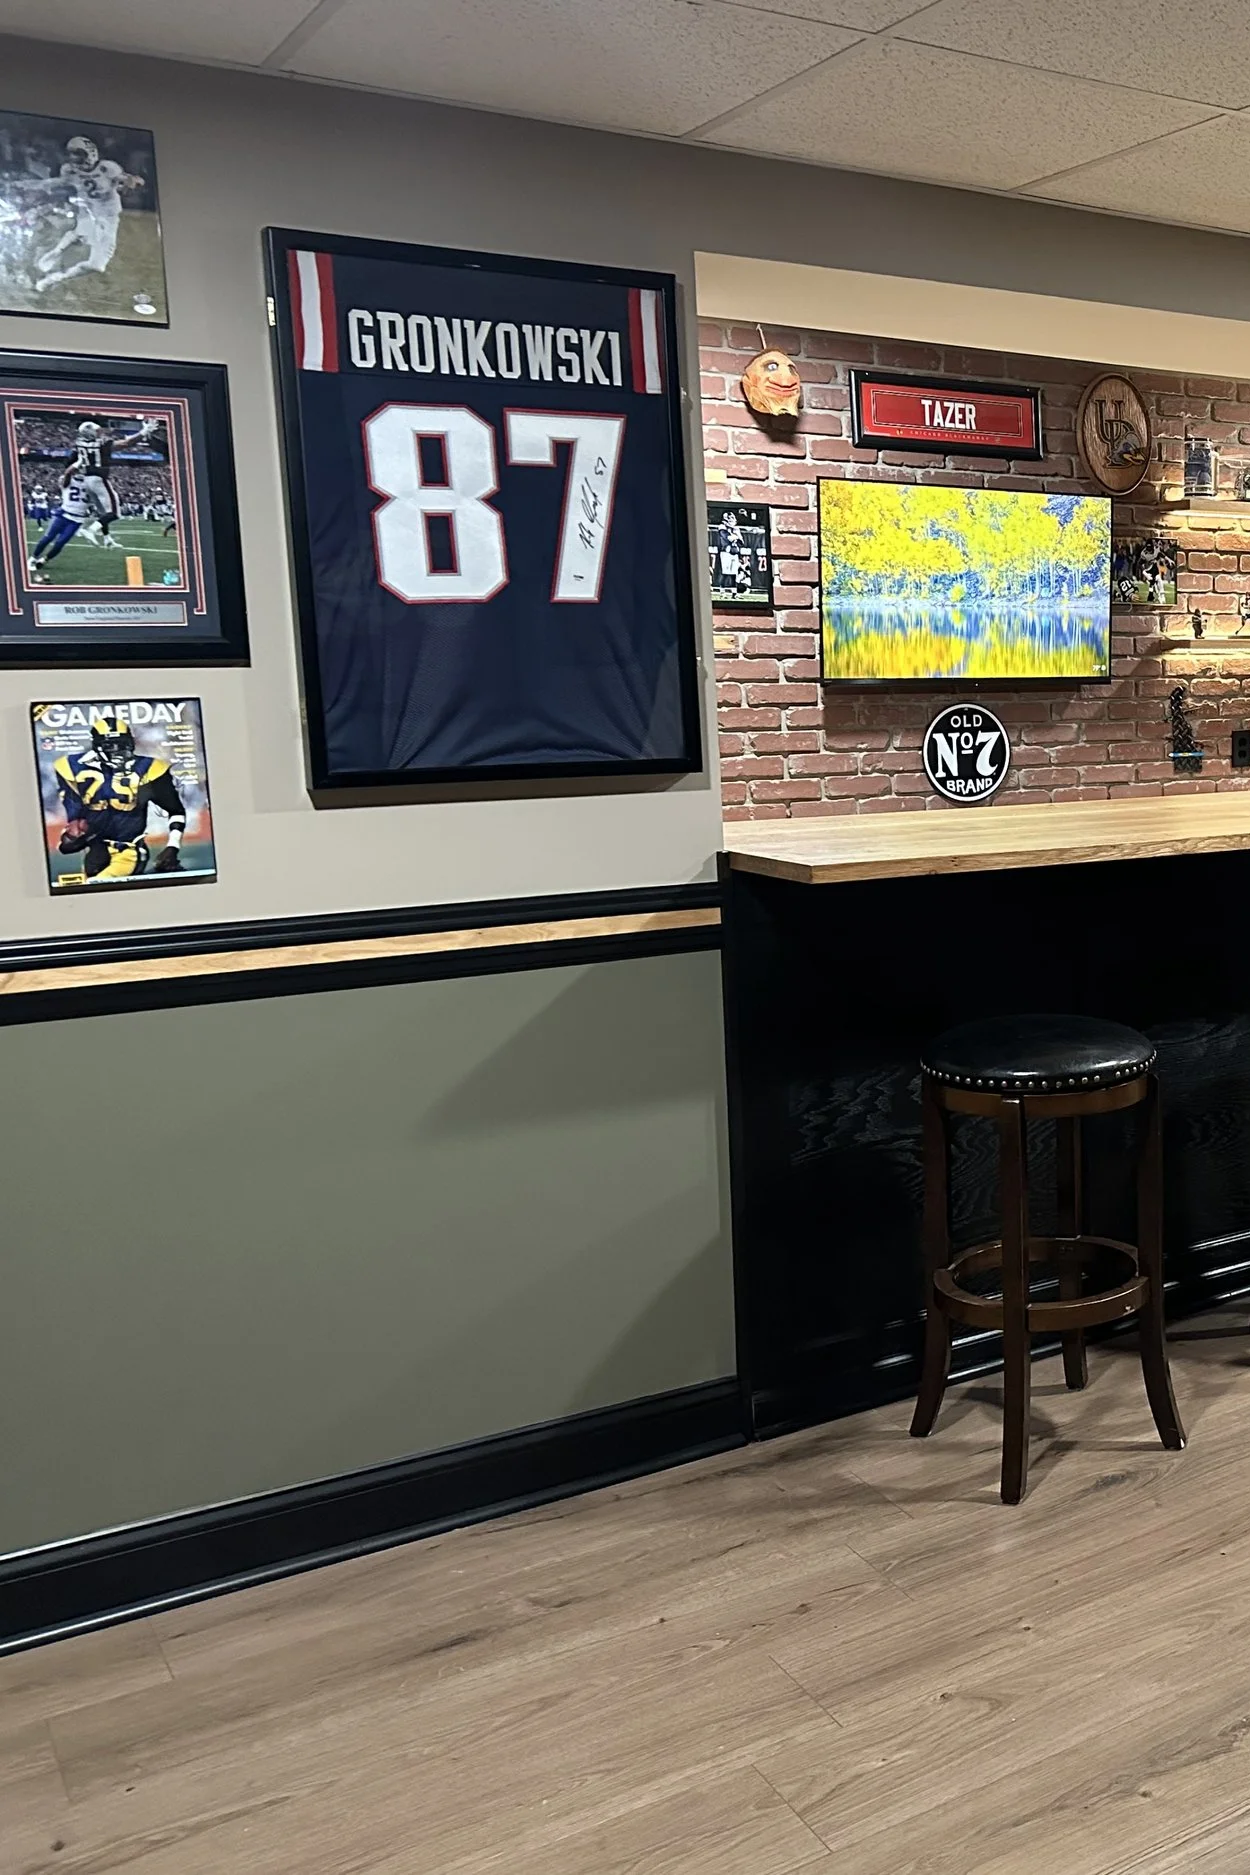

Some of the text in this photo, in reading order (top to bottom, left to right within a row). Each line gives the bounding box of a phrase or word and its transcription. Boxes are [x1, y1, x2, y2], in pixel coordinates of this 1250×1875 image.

[348, 308, 623, 387] GRONKOWSKI
[921, 399, 977, 430] TAZER
[360, 401, 628, 604] 87
[88, 605, 158, 615] GRONKOWSKI
[950, 714, 983, 728] OLD
[946, 777, 993, 795] BRAND
